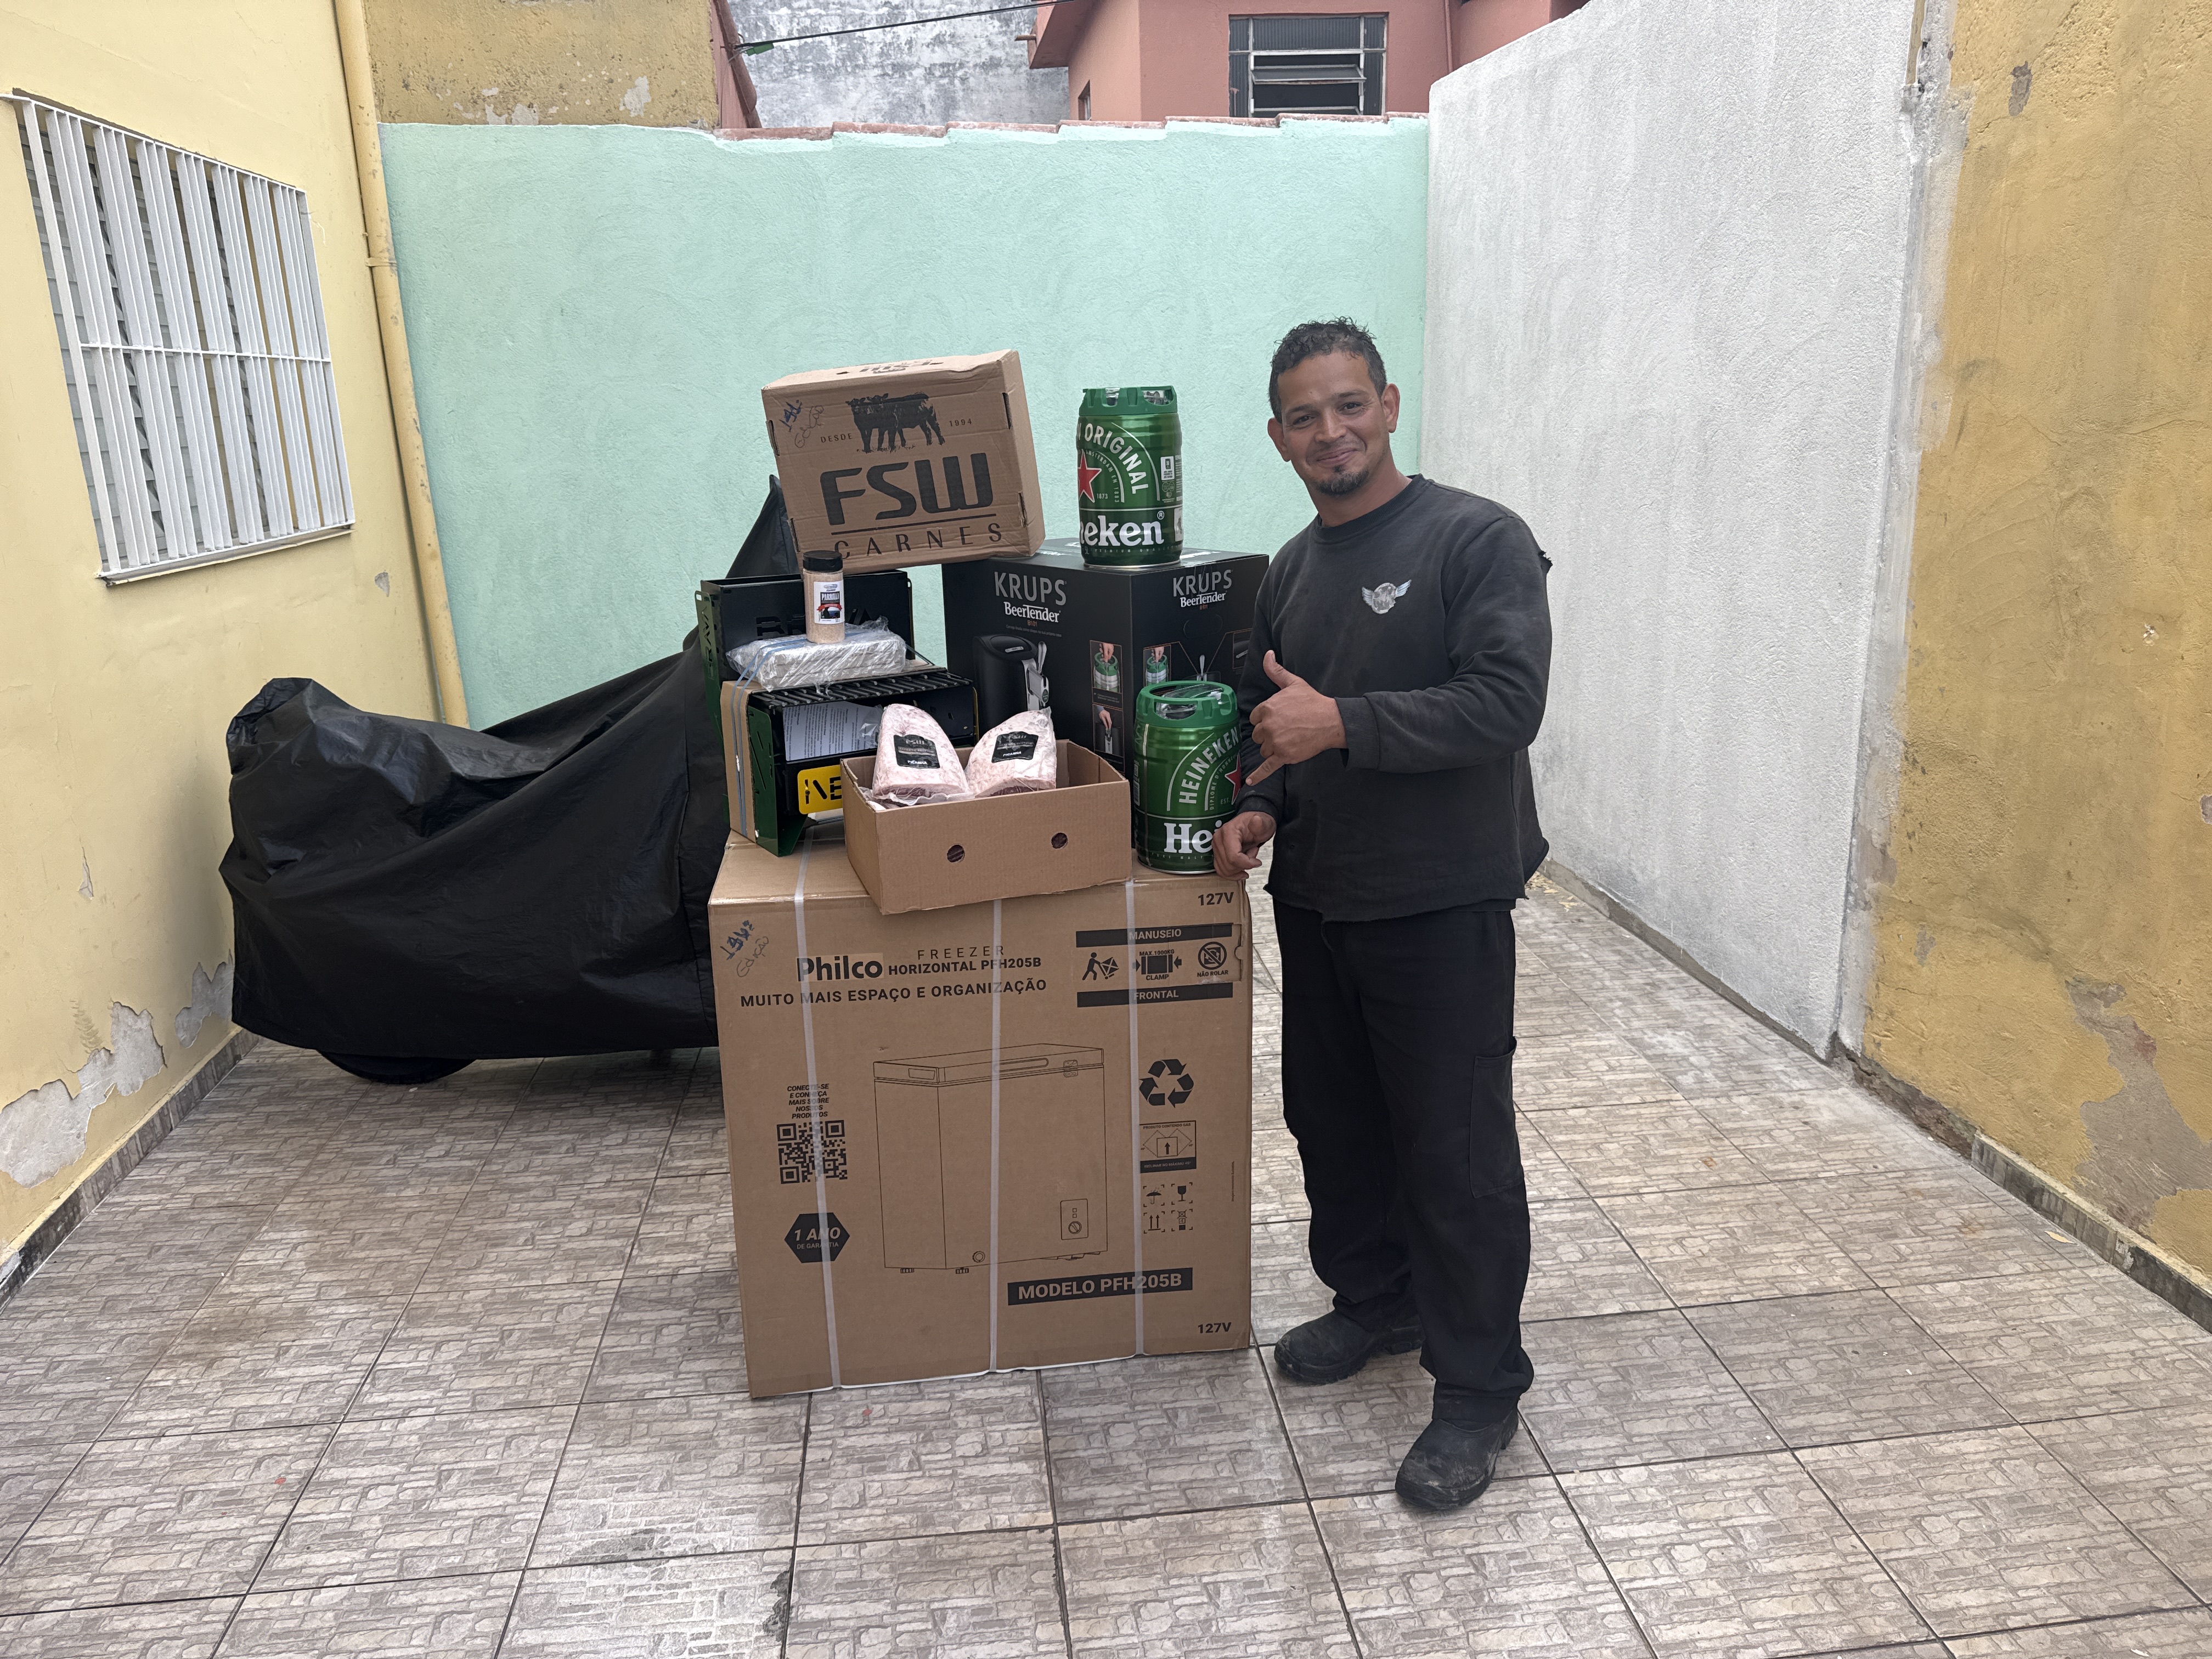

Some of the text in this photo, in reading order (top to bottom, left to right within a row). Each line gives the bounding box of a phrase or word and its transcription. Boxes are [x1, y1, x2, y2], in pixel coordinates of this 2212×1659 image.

[821, 418, 973, 443] DESDE 1994
[1084, 423, 1149, 494] ORIGINAL
[820, 453, 994, 526] FSW
[1111, 475, 1118, 483] EN
[834, 523, 1002, 560] CARNES
[994, 571, 1066, 606] KRUPS
[1173, 569, 1232, 597] KRUPS
[1180, 592, 1226, 607] BeerTender
[1003, 601, 1060, 623] BeerTender
[1179, 726, 1239, 804] HEINEKEN
[1198, 891, 1234, 906] 127V
[1128, 929, 1182, 940] MANUSEIO
[918, 945, 1004, 960] FREEZER
[797, 955, 883, 982] Philco
[889, 957, 1041, 975] HORIZONTAL PFH205B
[741, 978, 1046, 1007] MUITO MAIS ESPAÇO E ORGANIZAÇÃO
[1134, 990, 1179, 1000] FRONTAL
[787, 1084, 829, 1092] CONECTE-SE
[794, 1229, 801, 1242] 1
[1018, 1273, 1182, 1300] MODELO PFH205B
[1198, 1322, 1232, 1334] 127V
